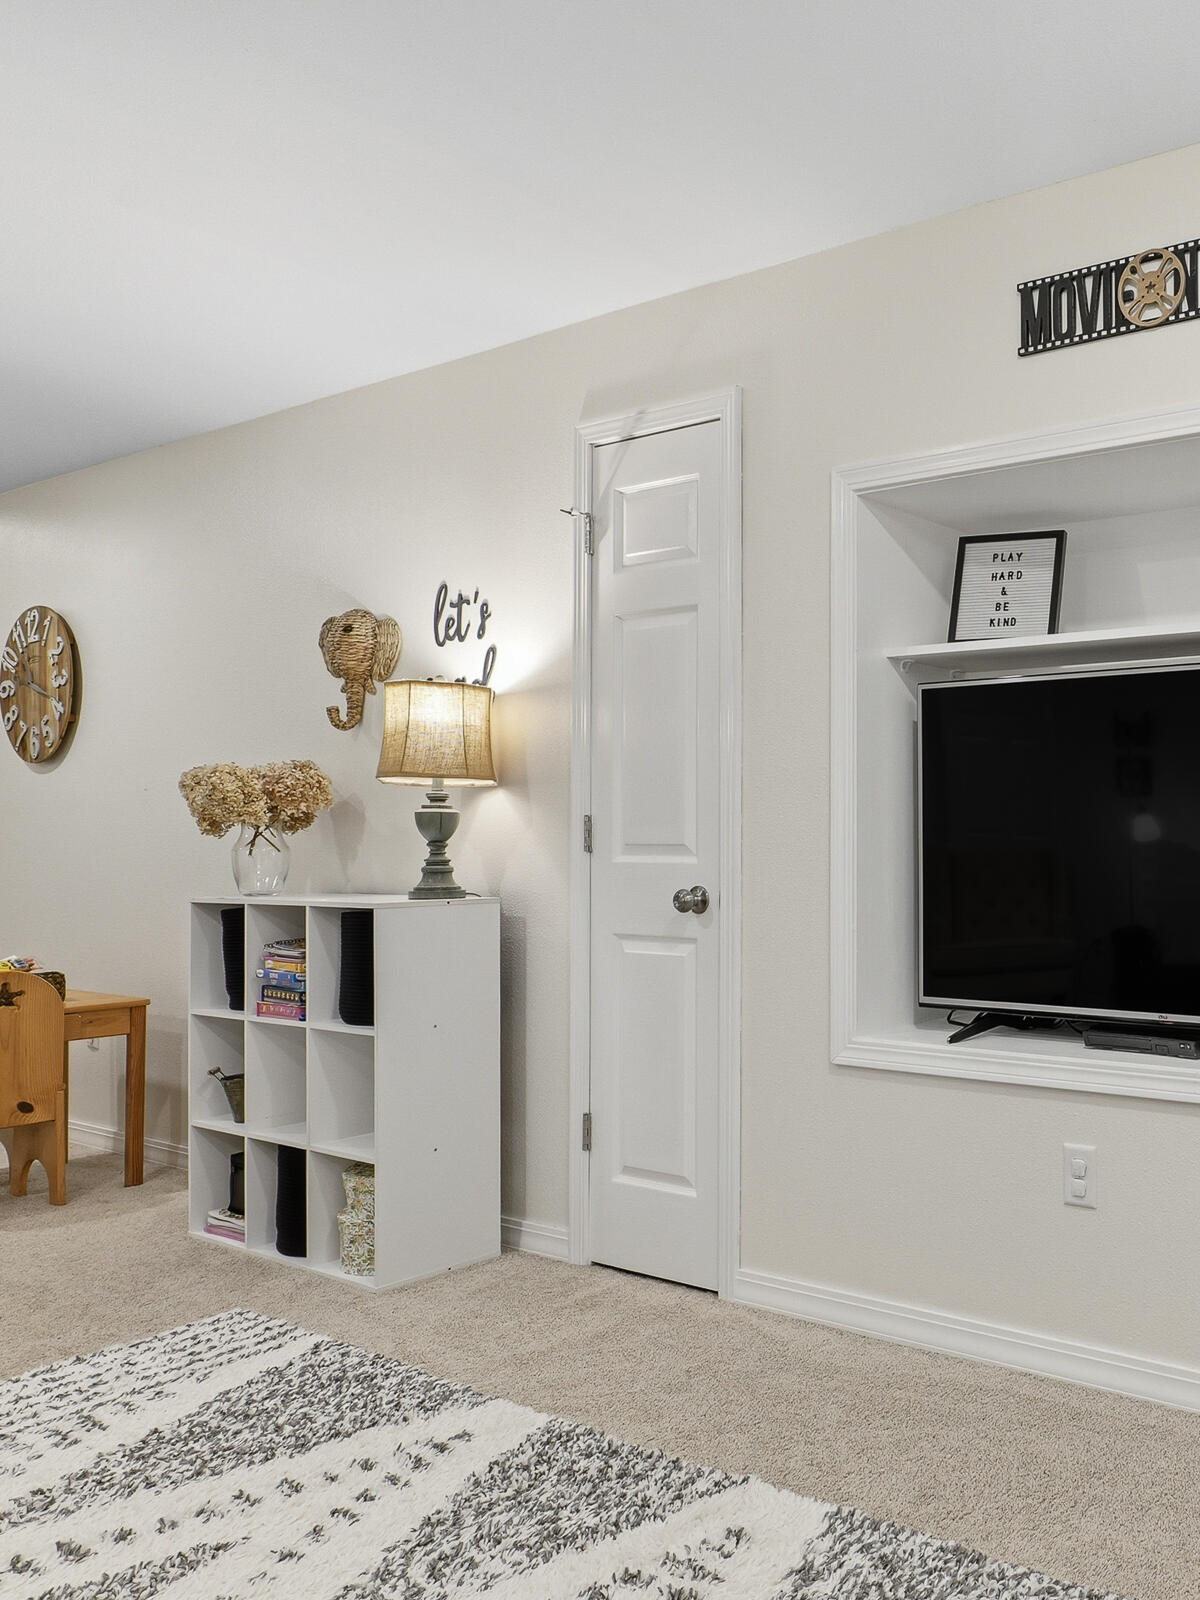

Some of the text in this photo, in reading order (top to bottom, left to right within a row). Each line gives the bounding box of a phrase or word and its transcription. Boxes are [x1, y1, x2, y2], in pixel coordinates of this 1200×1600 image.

[992, 552, 1023, 562] PLAY
[991, 570, 1023, 581] HARD
[1001, 587, 1008, 595] &
[433, 583, 492, 647] let's
[995, 602, 1010, 611] BE
[25, 609, 40, 643] 12
[41, 615, 52, 647] 1
[989, 617, 1017, 627] KIND
[12, 620, 27, 654] 11
[1, 646, 18, 673] 10
[49, 636, 64, 666] 2
[52, 668, 68, 688] 3
[5, 706, 18, 731] 8
[51, 697, 64, 720] 4
[15, 720, 28, 751] 7
[30, 725, 40, 759] 6
[42, 715, 53, 746] 5
